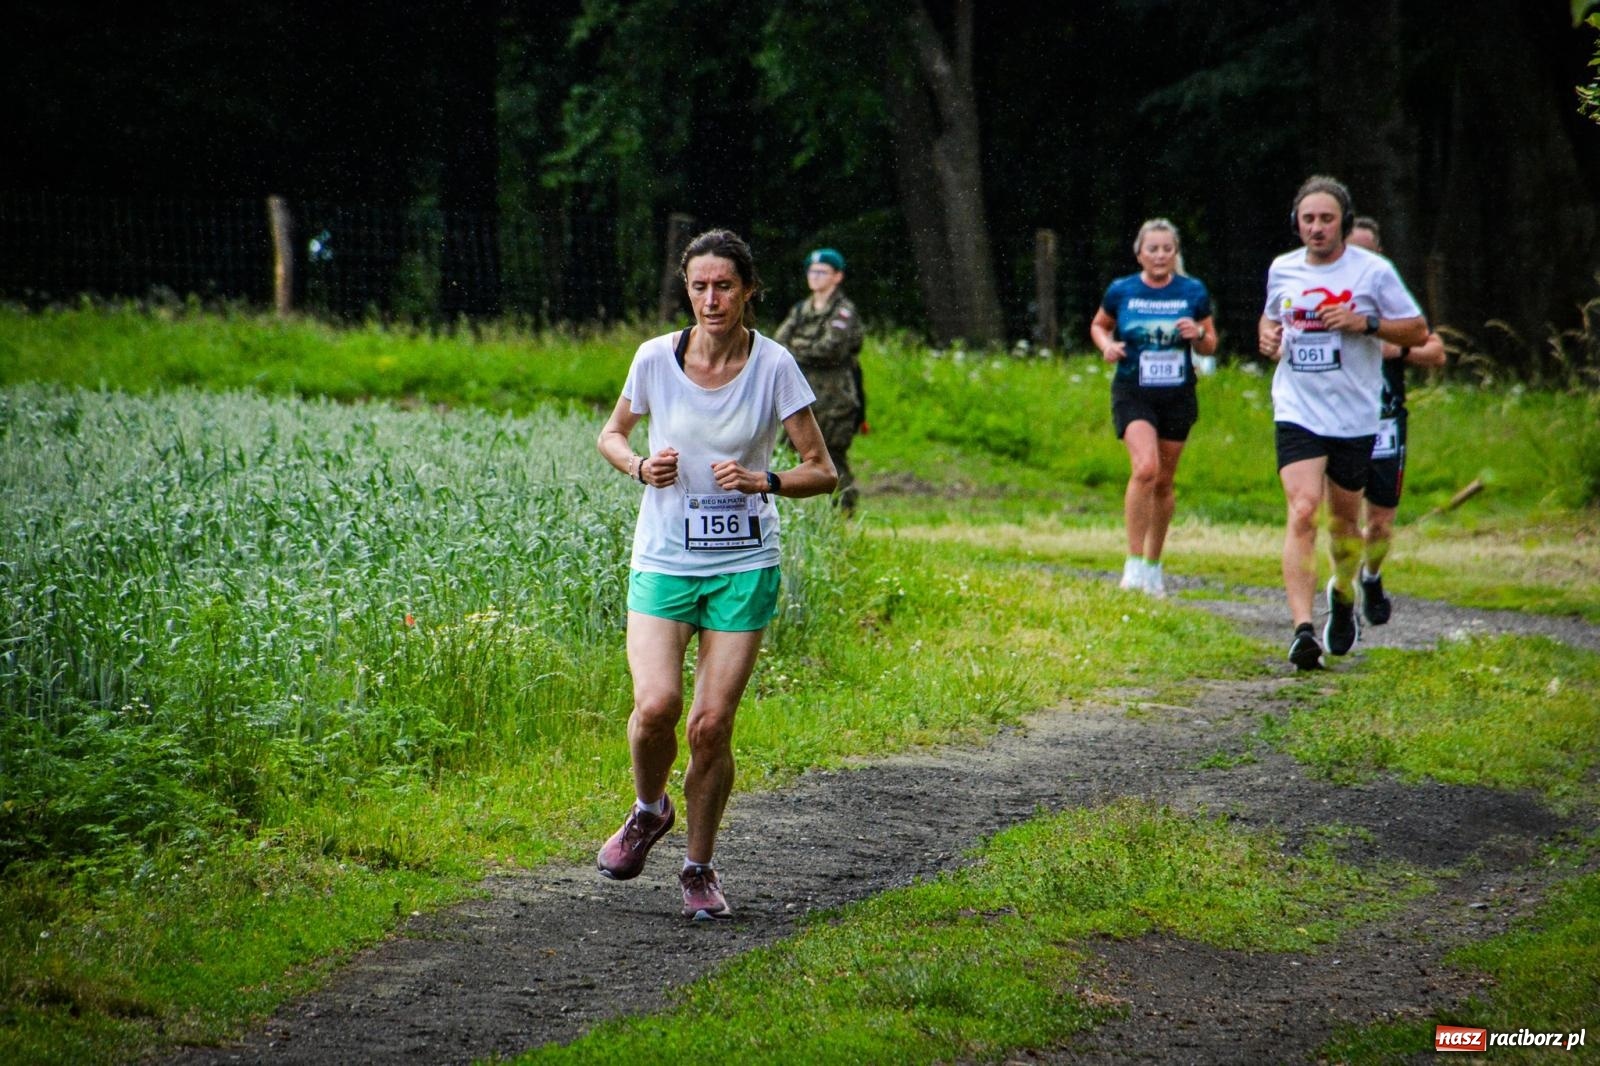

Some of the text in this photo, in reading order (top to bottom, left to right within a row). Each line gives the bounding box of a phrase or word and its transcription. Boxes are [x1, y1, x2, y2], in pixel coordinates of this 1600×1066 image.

[1298, 348, 1324, 361] 061
[1150, 364, 1172, 376] 018
[701, 514, 739, 535] 156
